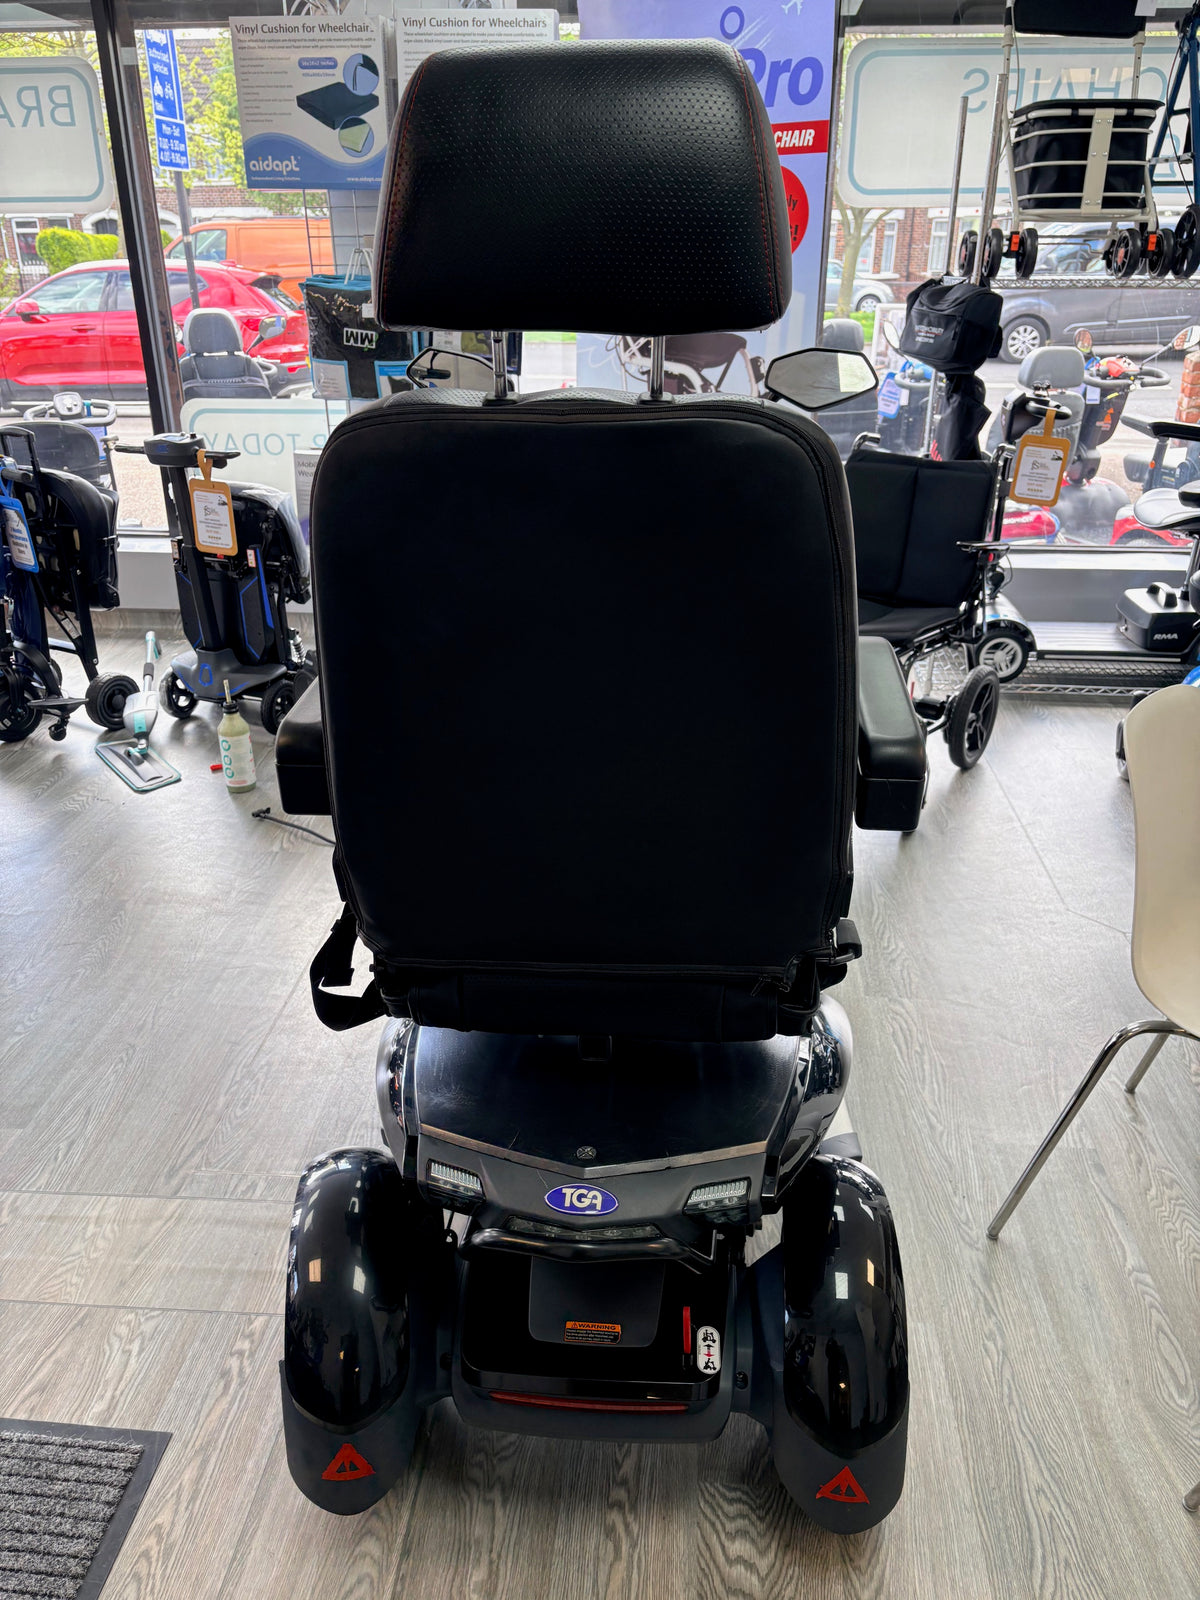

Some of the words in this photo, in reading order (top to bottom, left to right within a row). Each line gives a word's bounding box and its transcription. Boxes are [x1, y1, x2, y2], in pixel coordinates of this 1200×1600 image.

[235, 24, 258, 36] Vinyl
[261, 23, 300, 34] Cushion
[302, 23, 316, 33] for
[318, 22, 374, 33] Wheelchair
[402, 17, 426, 30] Vinyl
[429, 17, 469, 27] Cushion
[472, 17, 486, 27] for
[488, 17, 547, 28] Wheelchairs
[775, 129, 815, 148] CHAIR
[250, 155, 300, 175] aidapt
[562, 1188, 602, 1210] TGA
